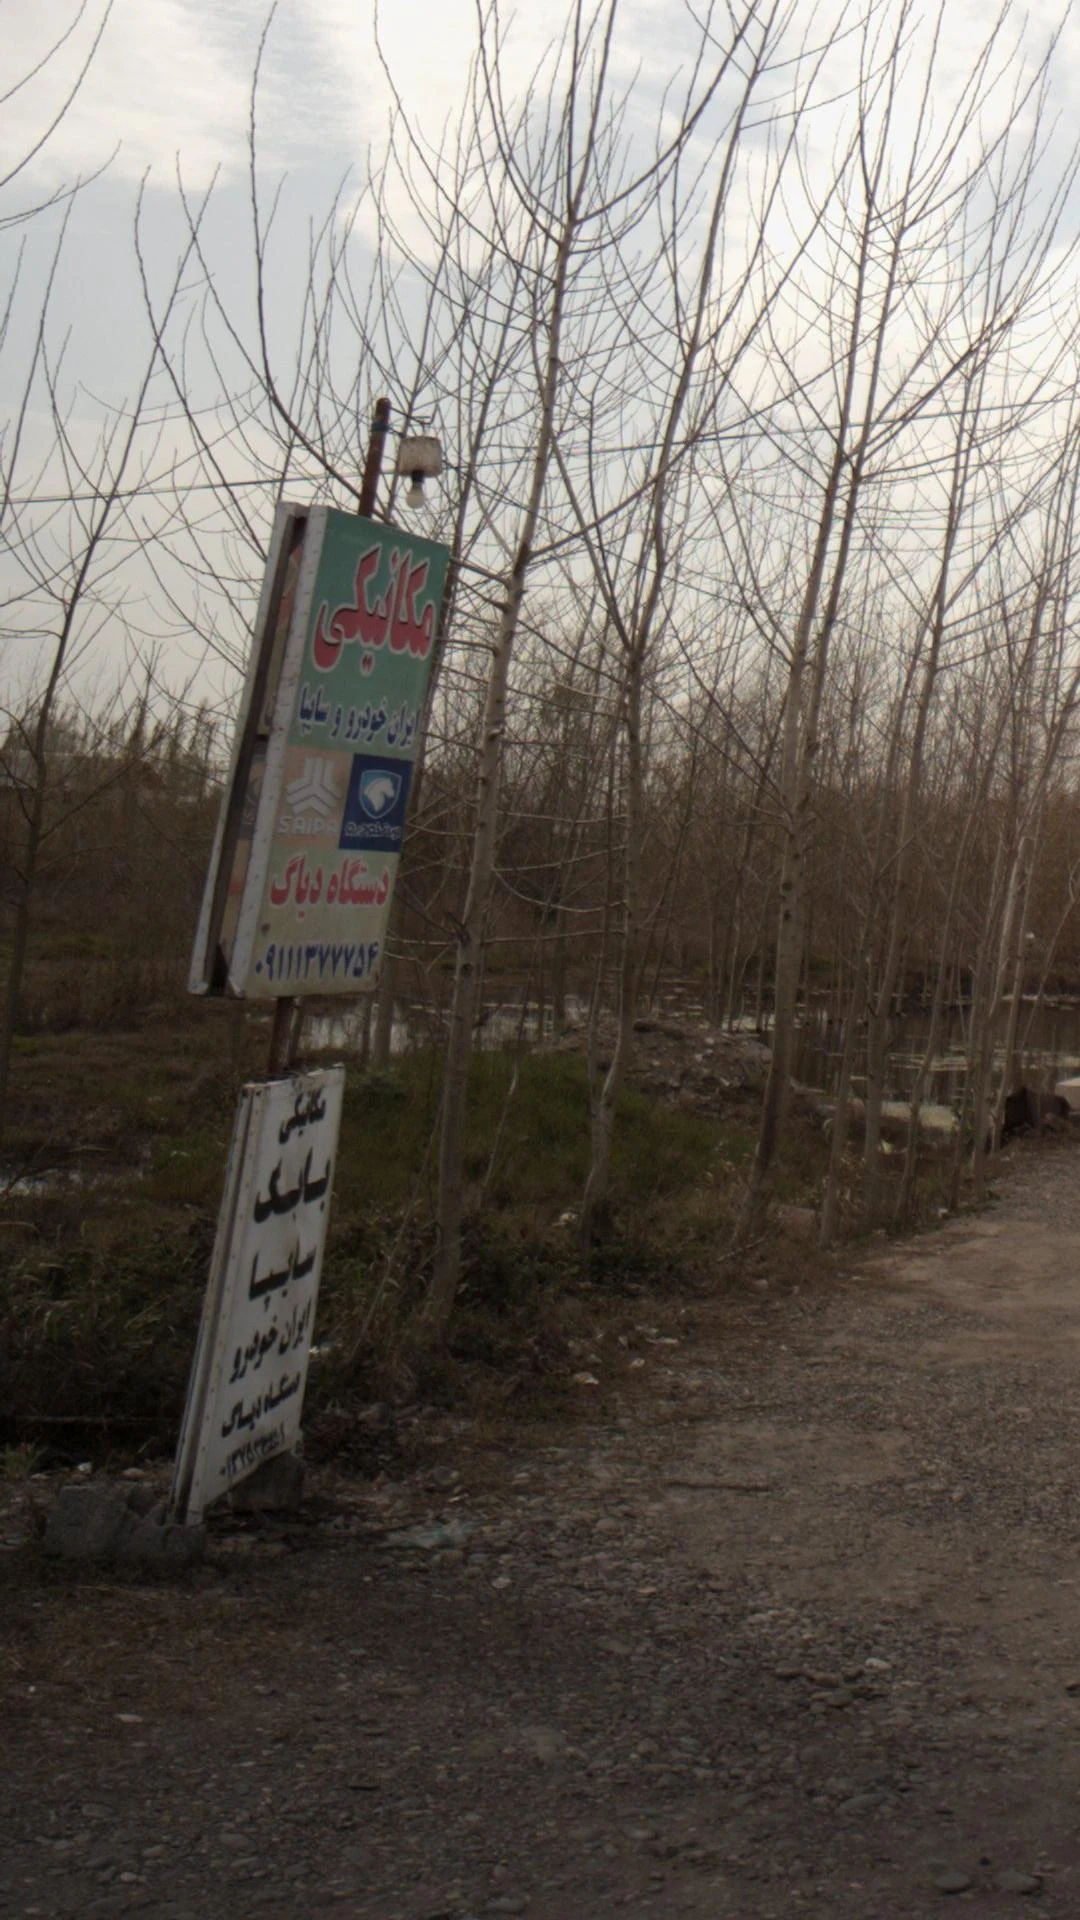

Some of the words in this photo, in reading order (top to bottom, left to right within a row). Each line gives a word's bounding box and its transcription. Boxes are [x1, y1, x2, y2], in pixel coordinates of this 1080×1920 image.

[312, 543, 435, 675] مکانیکی
[299, 685, 328, 737] سایپا
[330, 705, 342, 738] و
[345, 697, 387, 742] خودرو
[386, 702, 421, 748] ایران
[277, 816, 338, 836] SAIPA
[269, 853, 323, 921] دیاگ
[326, 856, 391, 907] دستگاه
[229, 1314, 278, 1384] خودرو
[279, 1298, 311, 1355] ایران
